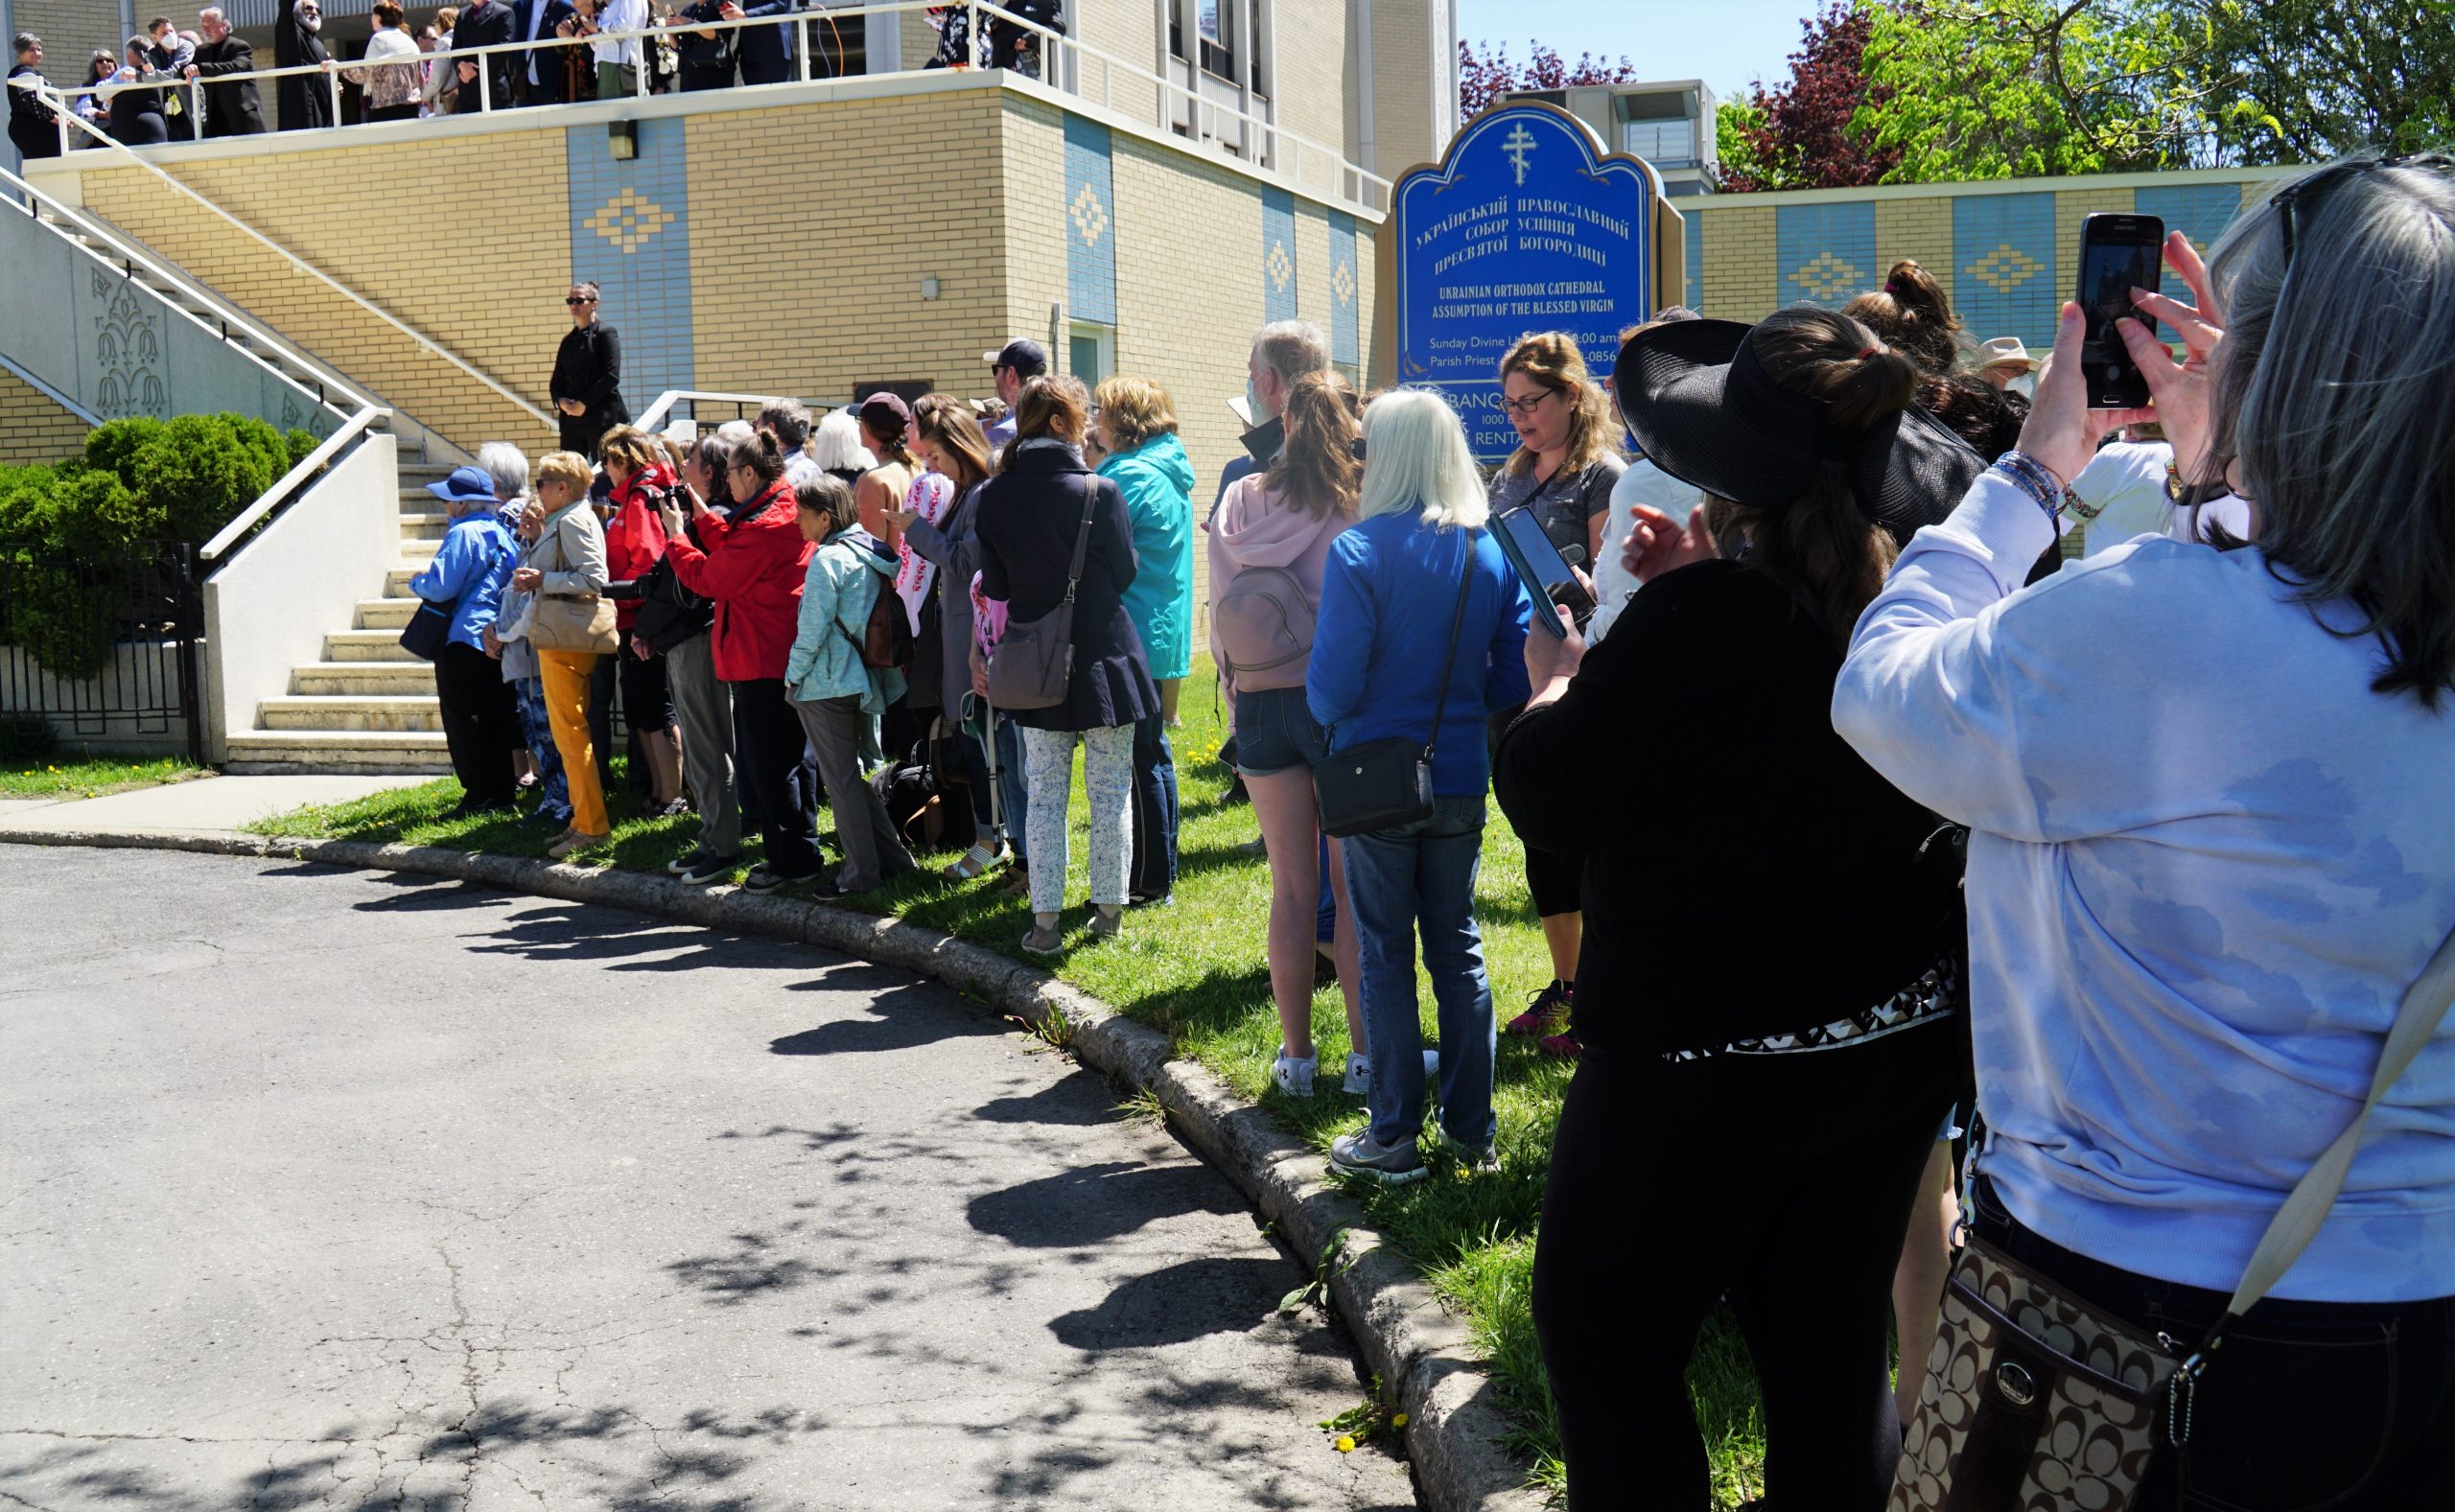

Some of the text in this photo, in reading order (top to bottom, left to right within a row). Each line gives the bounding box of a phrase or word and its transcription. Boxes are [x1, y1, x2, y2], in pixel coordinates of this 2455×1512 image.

[1415, 195, 1629, 250] УКРАЇНСЬКИЙ ПРАВОСЛАВНИЙ
[1465, 216, 1576, 242] СОБОР УСПІННЯ
[1435, 236, 1606, 276] ПРЕСВЯТОЇ БОГОРОДИЦІ
[1439, 281, 1605, 299] UKRAINIAN ORTHODOX CATHEDRAL
[1432, 299, 1614, 318] ASSUMPTION OF THE BLESSED VIRGIN
[1430, 337, 1467, 351] Sunday
[1470, 337, 1505, 348] Divine
[1600, 335, 1617, 343] am
[1430, 351, 1617, 366] Parish Priest -0856
[1448, 392, 1504, 410] BANQ
[1482, 415, 1505, 425] 1000
[1476, 431, 1524, 445] RENTA
